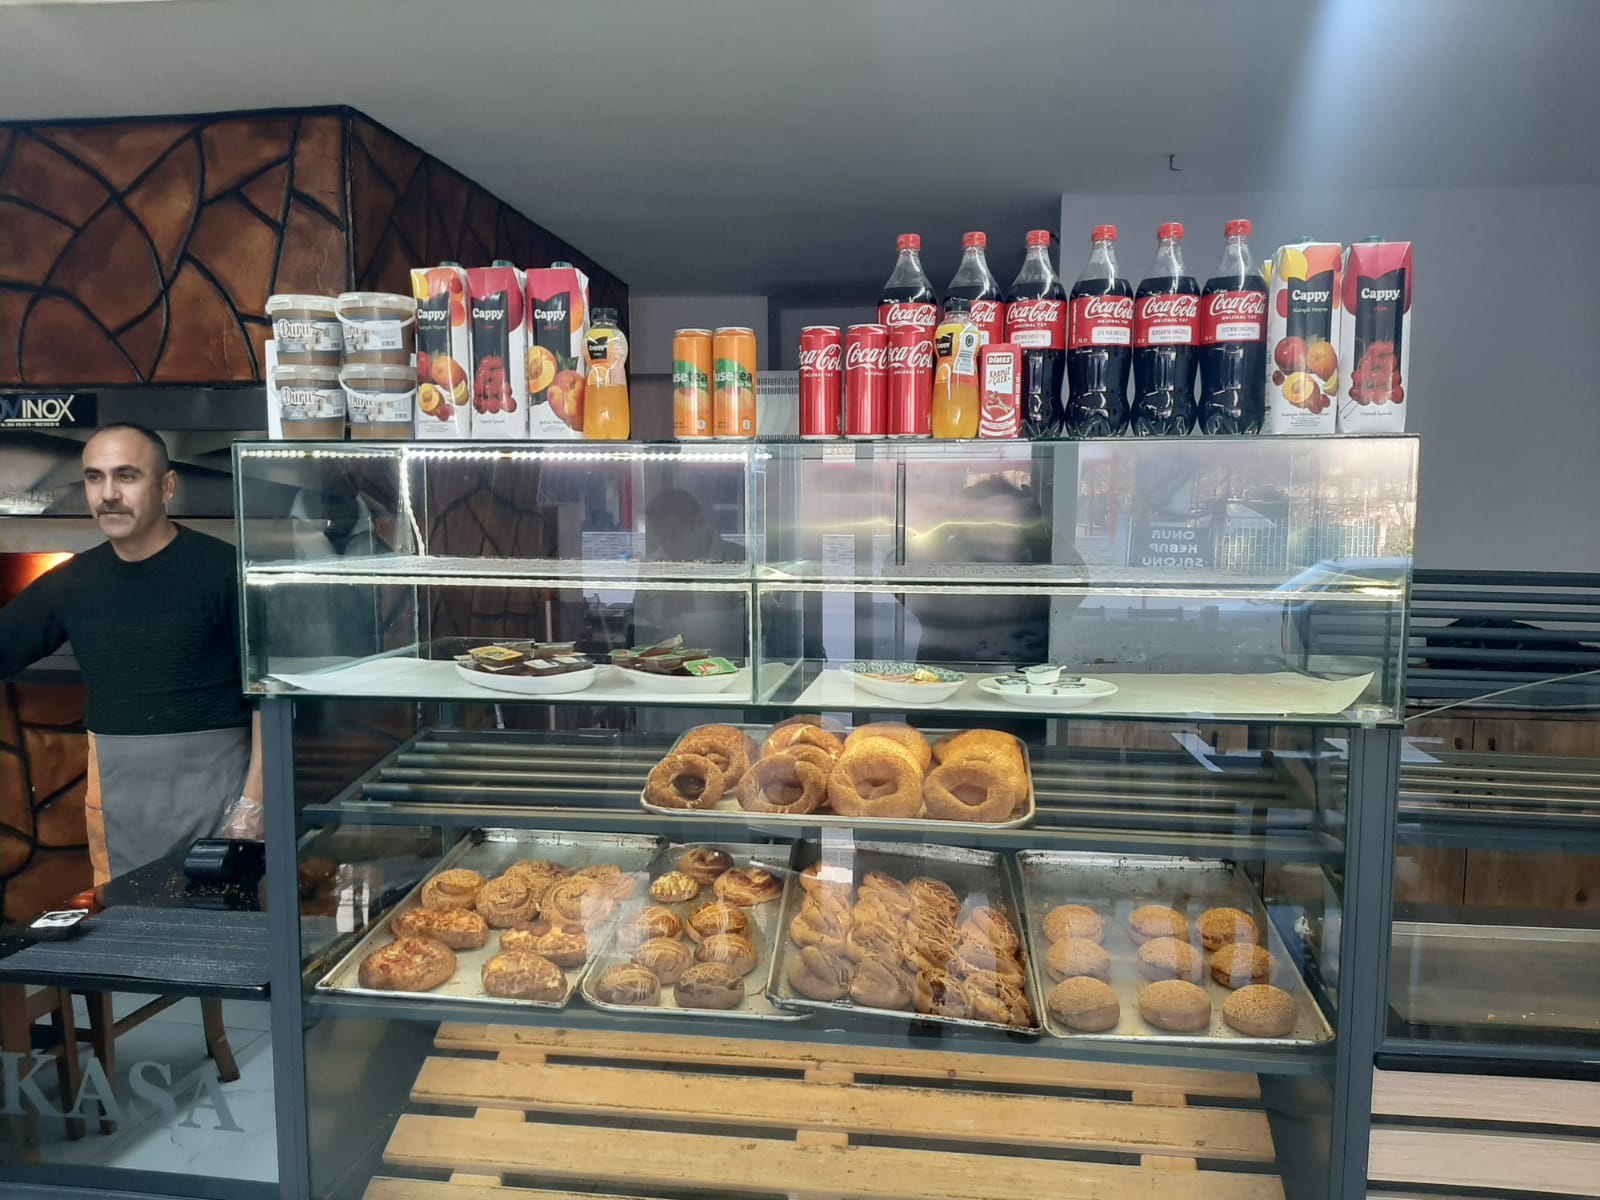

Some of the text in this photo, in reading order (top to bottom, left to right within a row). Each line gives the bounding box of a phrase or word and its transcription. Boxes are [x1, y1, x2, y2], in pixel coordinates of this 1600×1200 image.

[1292, 290, 1329, 302] Cappy
[1361, 288, 1400, 301] Cappy
[417, 309, 447, 321] Cappy
[472, 308, 504, 320] Cappy
[534, 309, 567, 321] Cappy
[969, 301, 999, 323] Cola
[279, 319, 312, 338] Duru
[280, 386, 313, 405] Duru
